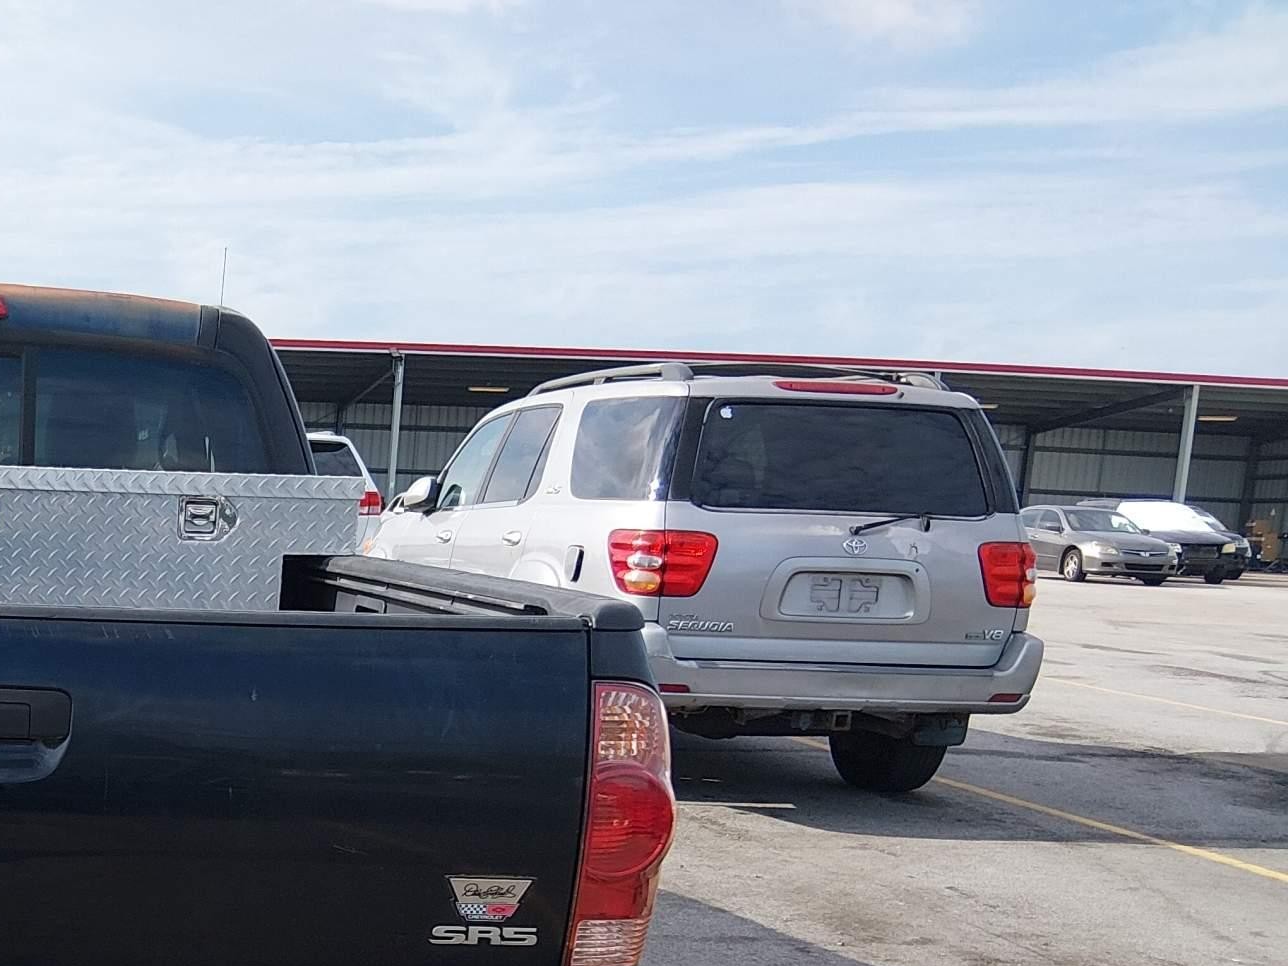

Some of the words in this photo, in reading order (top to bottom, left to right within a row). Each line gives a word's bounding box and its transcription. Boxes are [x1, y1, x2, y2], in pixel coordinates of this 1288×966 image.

[667, 620, 734, 632] SEQUOIA
[984, 629, 1004, 640] V8
[428, 925, 538, 946] SR5
